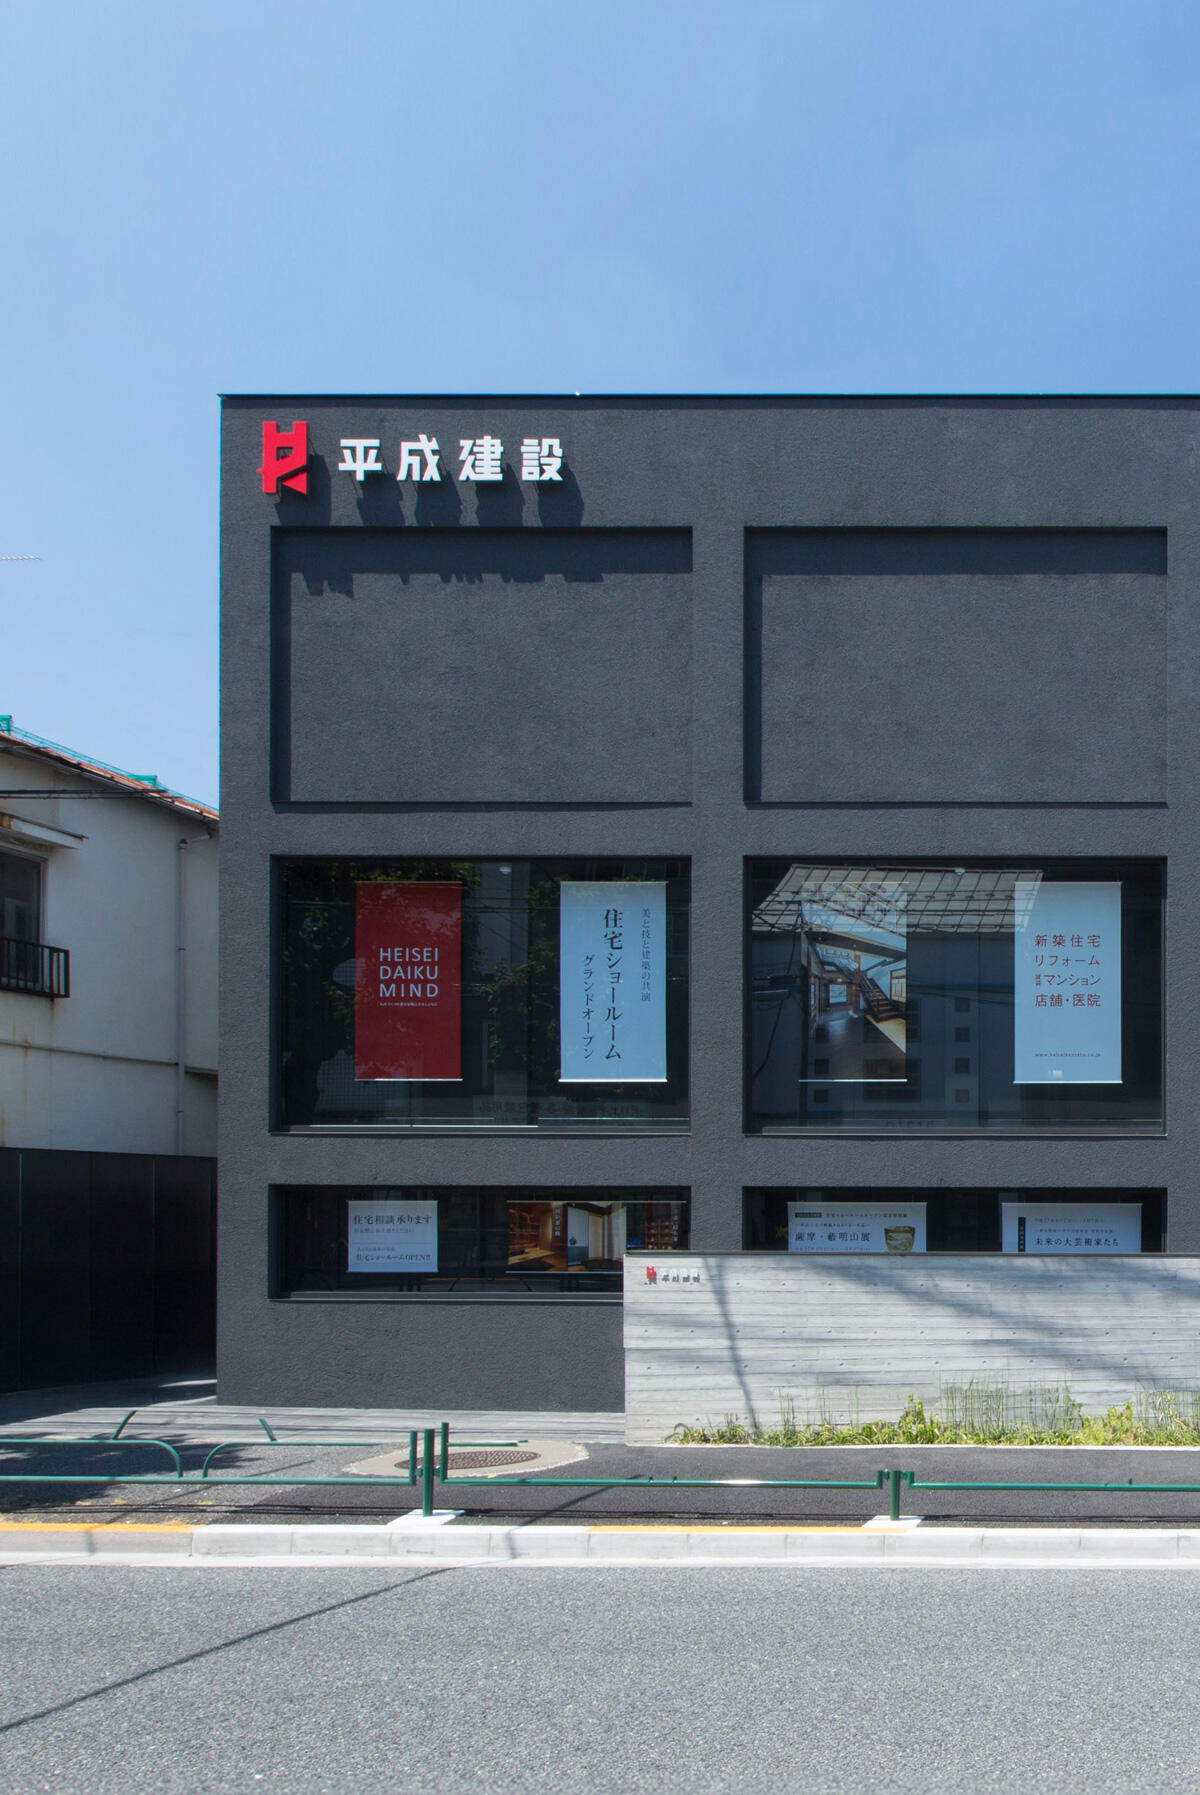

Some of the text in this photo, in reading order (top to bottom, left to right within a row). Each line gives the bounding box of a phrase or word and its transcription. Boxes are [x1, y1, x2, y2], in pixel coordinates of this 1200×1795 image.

[338, 434, 564, 481] 平成建設
[1034, 934, 1101, 948] 新築住宅
[379, 947, 439, 962] HEISEI
[1034, 954, 1101, 967] リフォーム
[379, 965, 439, 980] DAIKU
[379, 983, 439, 998] MIND
[603, 908, 623, 1060] 住宅ショールーム
[582, 954, 595, 1060] グランドオープン
[1034, 993, 1101, 1008] 店舗・医院
[353, 1215, 432, 1225] 住宅相談承ります
[1034, 1237, 1119, 1247] 未来の大芸術家たち
